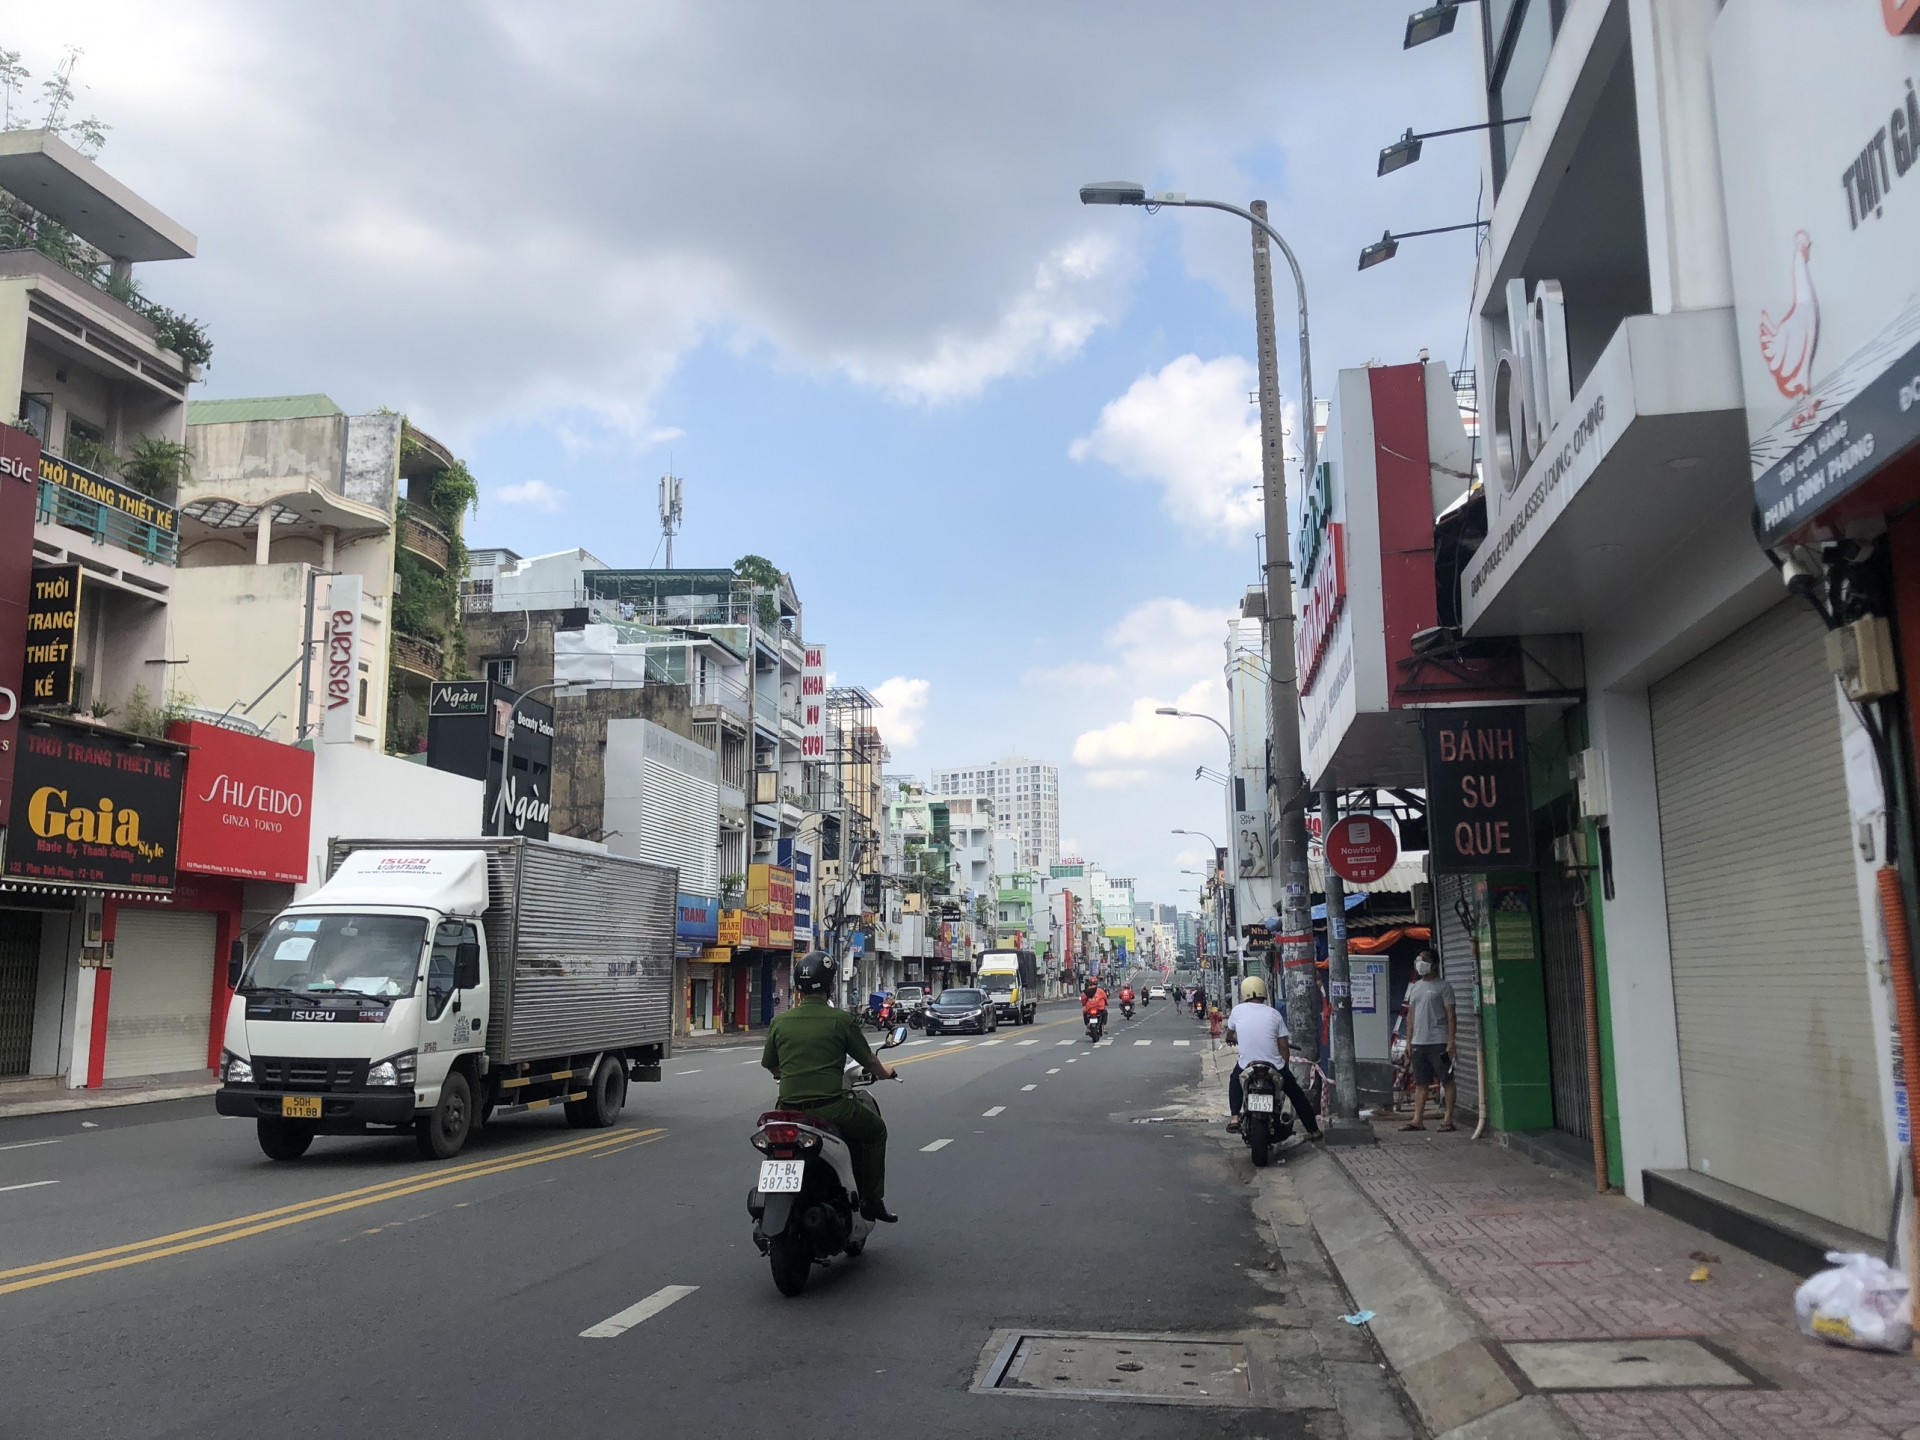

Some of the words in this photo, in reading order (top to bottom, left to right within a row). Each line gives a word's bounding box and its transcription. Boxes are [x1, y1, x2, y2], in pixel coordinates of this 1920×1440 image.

[1842, 125, 1891, 231] THỊT
[1764, 493, 1795, 532] PHAN
[1796, 468, 1827, 507] ĐÌNH
[1827, 432, 1876, 484] PHÙNG
[38, 459, 68, 486] THỜI
[72, 471, 115, 506] TRANG
[119, 492, 154, 521] THIẾT
[156, 507, 173, 530] KẾ
[36, 576, 70, 599] THỜI
[27, 611, 74, 631] TRANG
[27, 637, 69, 664] THIẾT
[327, 610, 353, 711] vascara
[805, 649, 822, 667] NHA
[34, 671, 55, 697] KẾ
[802, 675, 824, 696] KHOA
[433, 687, 478, 708] Ngàn
[517, 710, 539, 733] Beauty
[538, 719, 554, 737] Salon
[1439, 720, 1514, 762] BÁNH
[67, 743, 112, 767] TRANG
[199, 774, 303, 817] SHISEIDO
[1461, 775, 1497, 809] SU
[491, 775, 549, 831] Ngàn
[28, 786, 140, 847] Gaia
[222, 813, 250, 828] GINZA
[254, 818, 283, 833] TOKYO
[36, 839, 63, 854] Made
[66, 841, 78, 859] By
[1454, 821, 1511, 856] QUE
[138, 841, 164, 863] Style
[1340, 845, 1382, 855] NowFood
[1061, 857, 1085, 865] HOTEL
[719, 919, 740, 931] THÀNH
[1251, 927, 1268, 935] Nha
[720, 932, 739, 941] PHONG
[291, 1010, 336, 1021] ISUZU
[286, 1106, 319, 1117] 011.88
[293, 1097, 311, 1107] 50H
[1249, 1102, 1272, 1111] 701.57
[767, 1163, 797, 1176] 71-B4
[761, 1176, 800, 1190] 387.53
